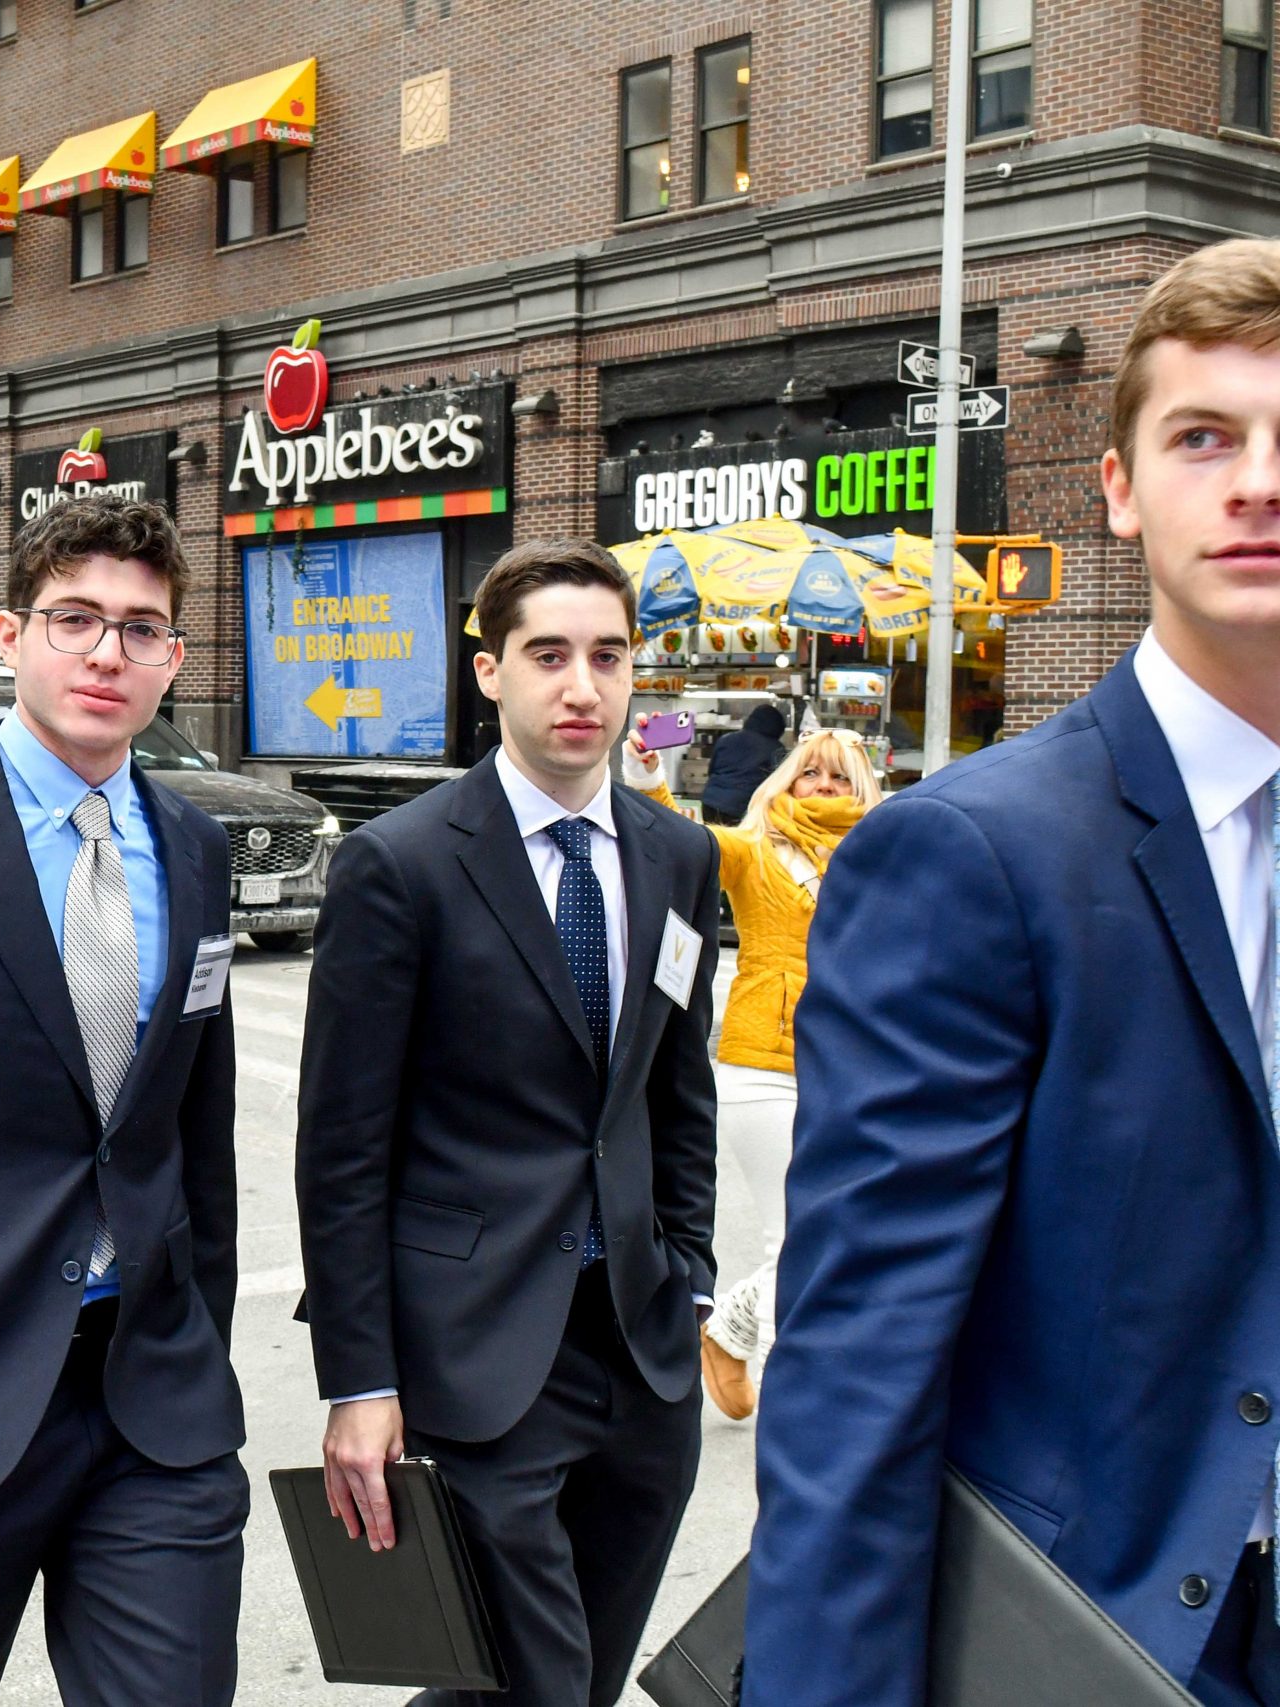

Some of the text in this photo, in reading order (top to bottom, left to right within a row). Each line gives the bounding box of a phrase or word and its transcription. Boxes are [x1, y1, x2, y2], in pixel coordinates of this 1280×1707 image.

[914, 357, 936, 375] ONE
[922, 400, 992, 421] ON WAY
[228, 405, 481, 506] Applebee's
[635, 458, 805, 532] GREGORYS
[293, 594, 392, 626] ENTRANCE
[274, 630, 415, 663] ON BROADWAY
